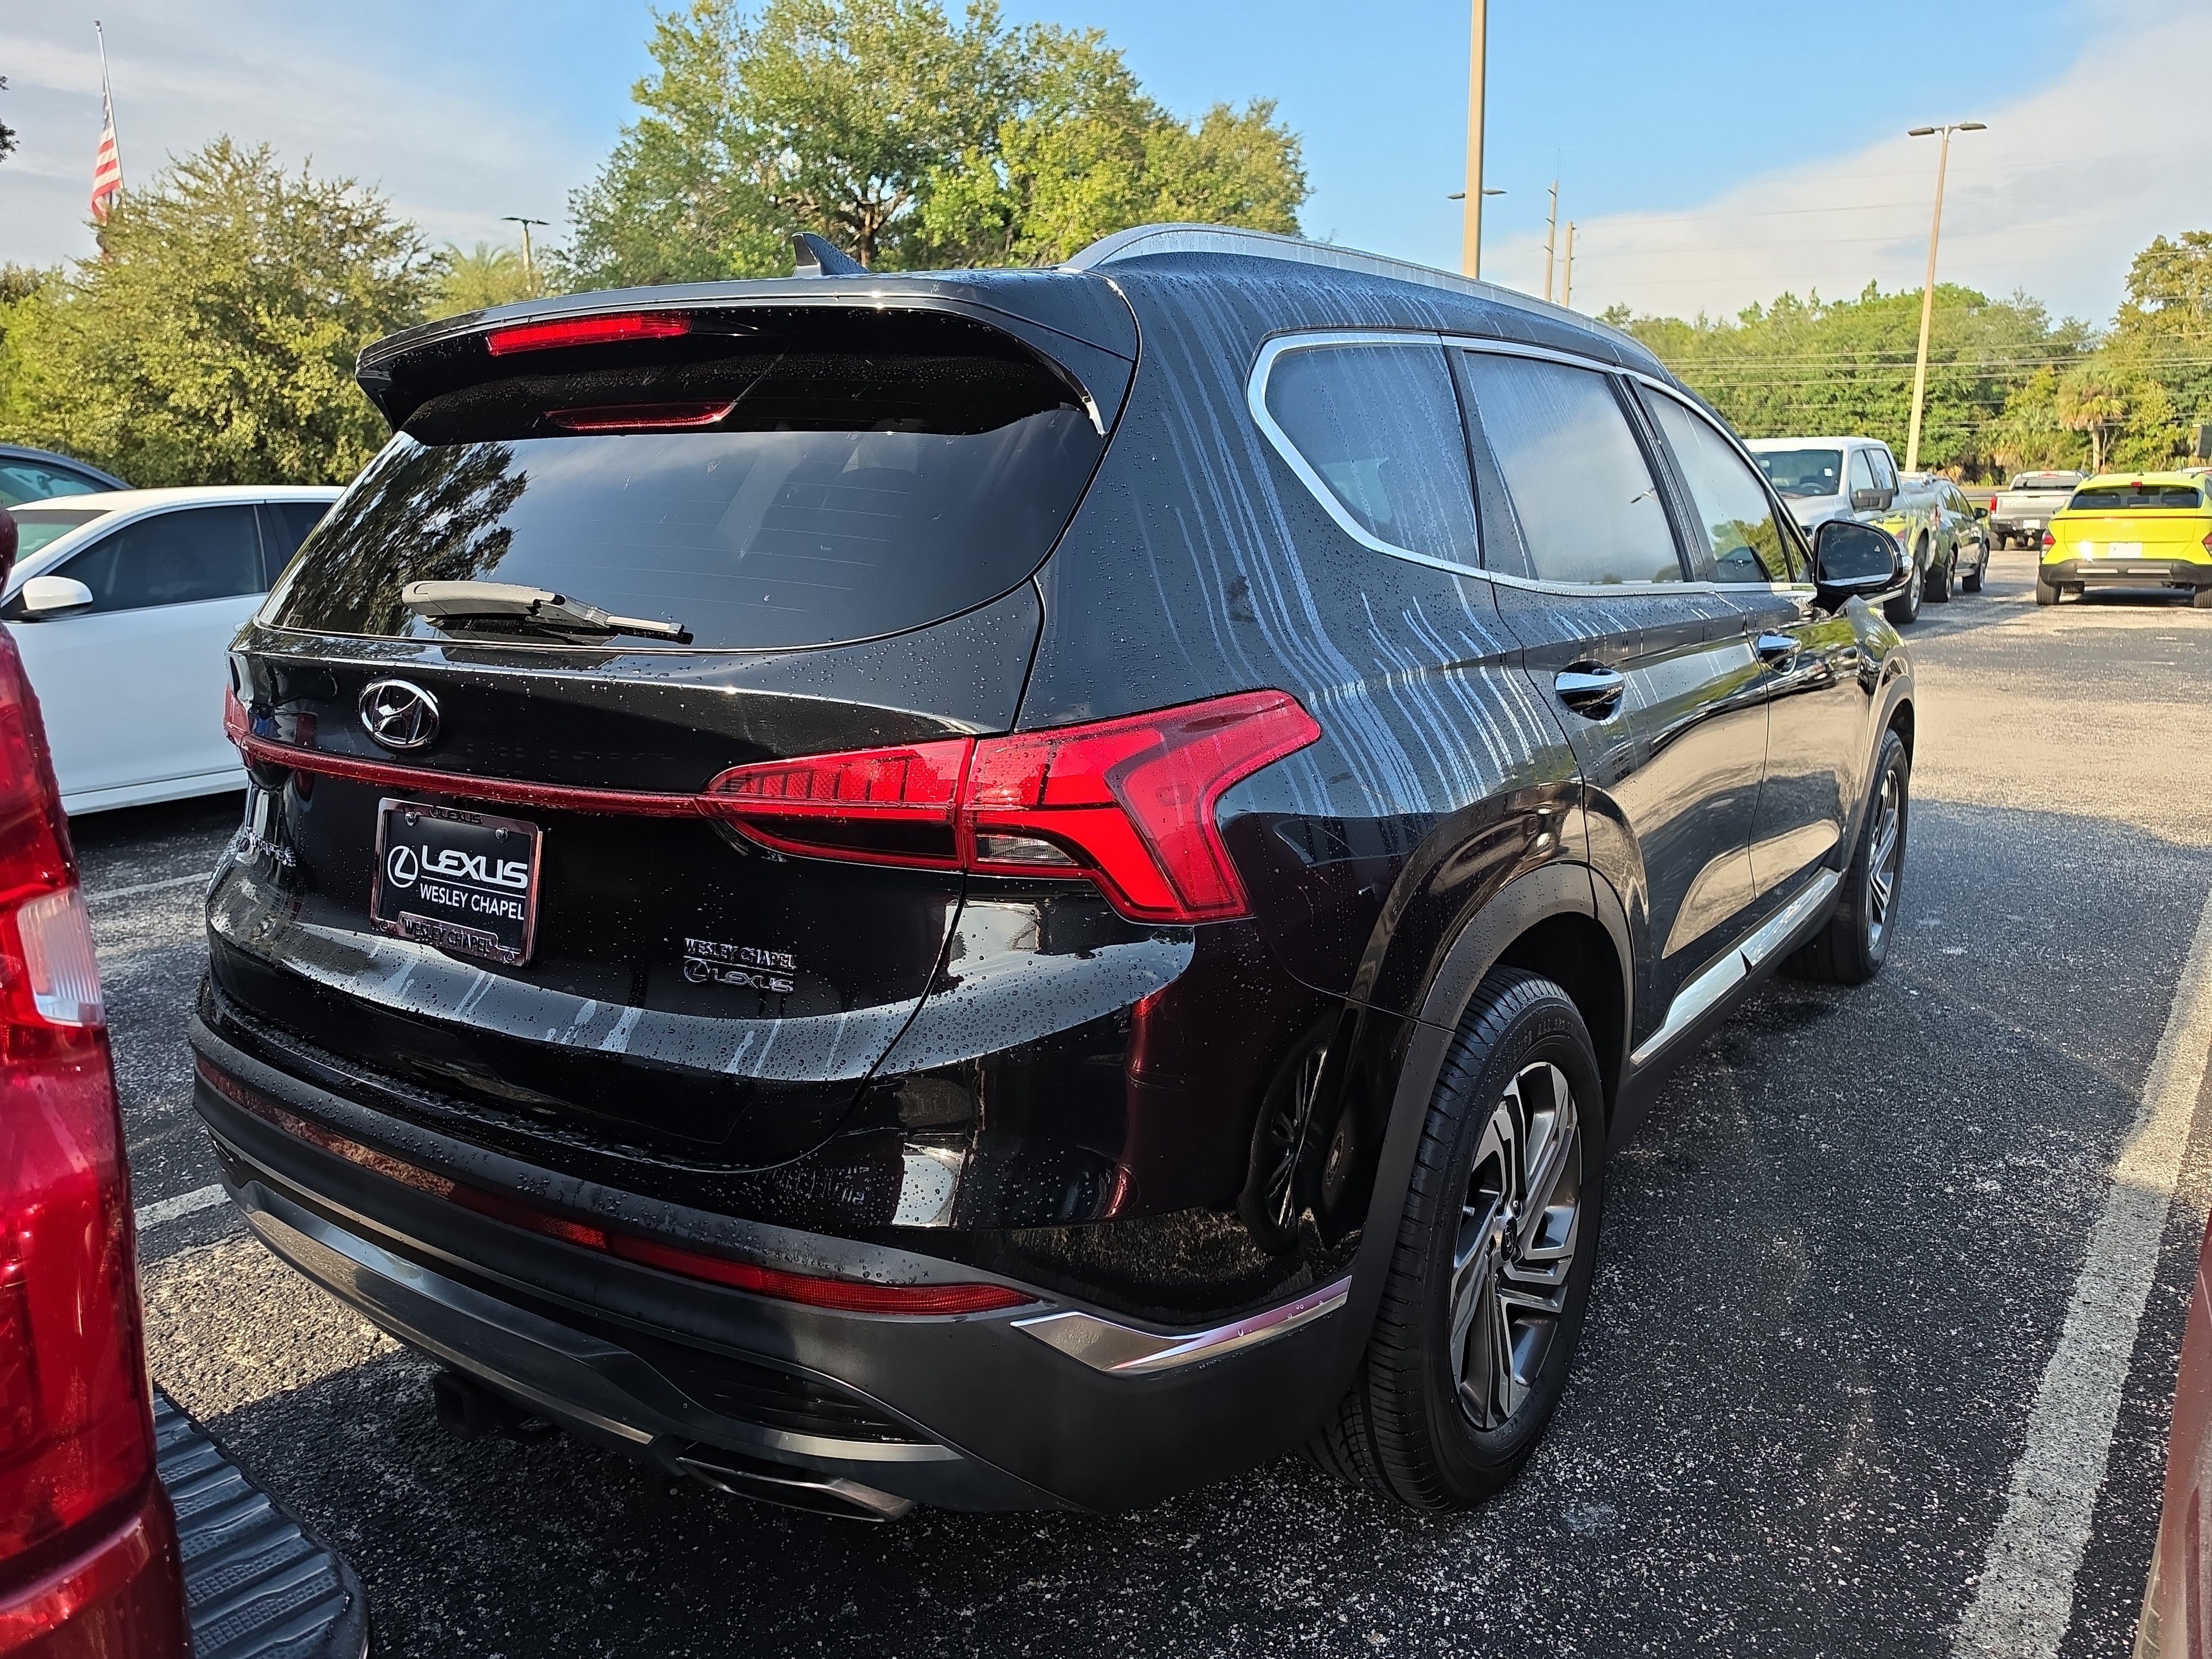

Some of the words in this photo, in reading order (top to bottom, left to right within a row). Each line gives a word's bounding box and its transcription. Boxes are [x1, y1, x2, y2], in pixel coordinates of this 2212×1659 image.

[440, 809, 483, 825] LEXUS
[421, 845, 528, 889] LEXUS
[420, 883, 468, 908] WESLEY
[471, 894, 525, 921] CHAPEL
[404, 917, 447, 943] WESLEY
[447, 929, 491, 954] CHAPEL
[684, 937, 739, 962] WESLEY
[740, 947, 797, 969] CHAPEL
[711, 968, 795, 993] LEXUS
